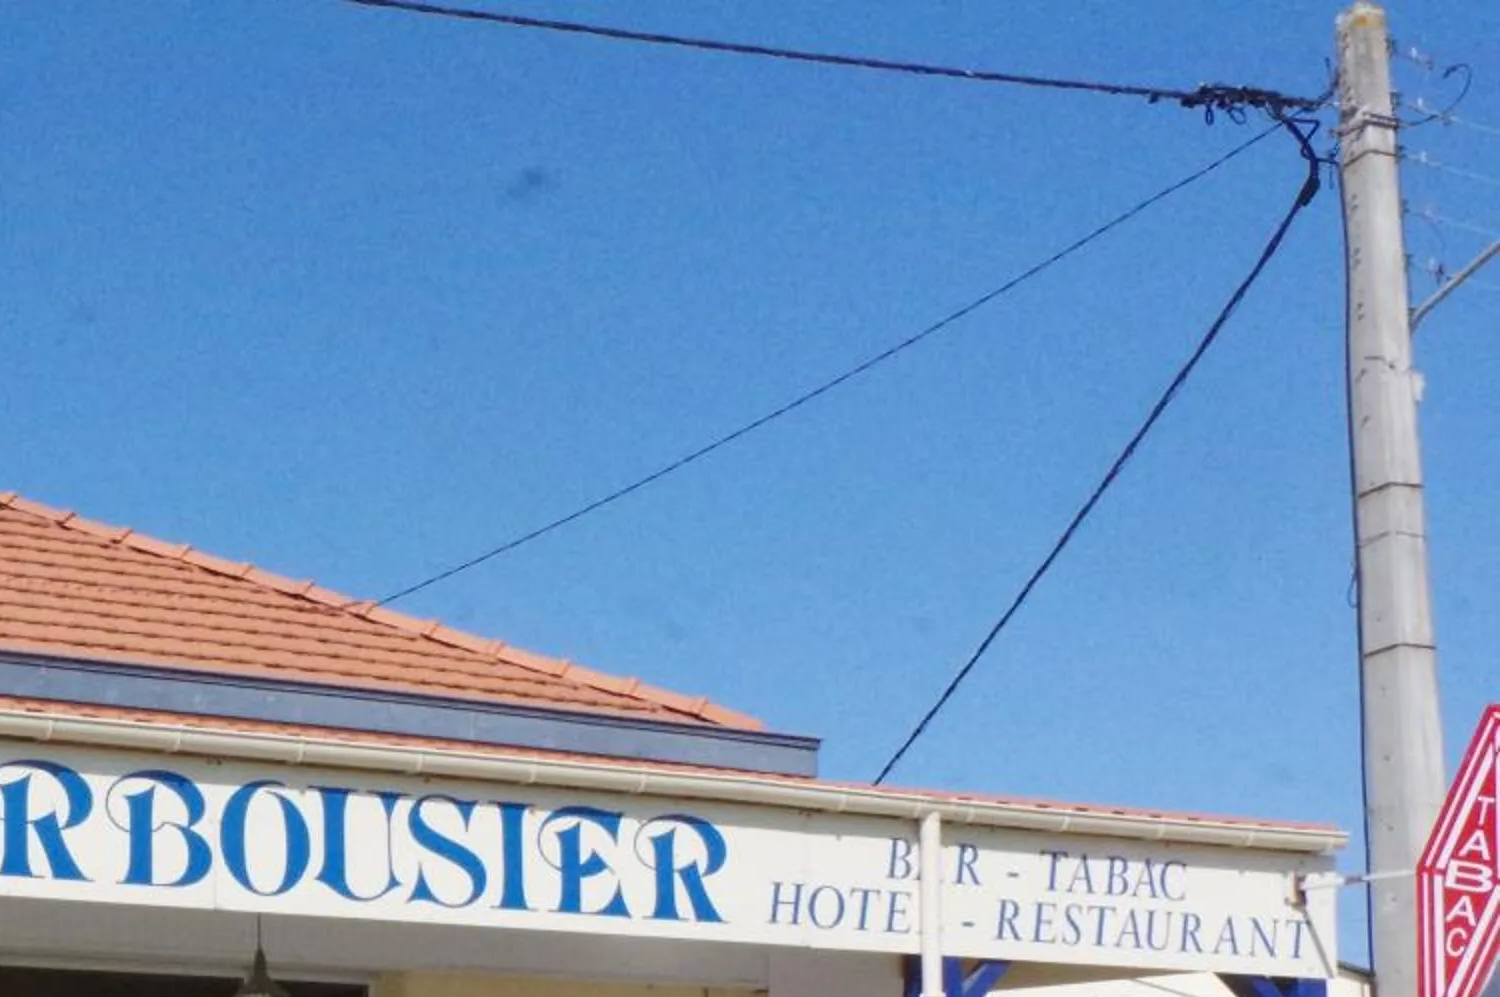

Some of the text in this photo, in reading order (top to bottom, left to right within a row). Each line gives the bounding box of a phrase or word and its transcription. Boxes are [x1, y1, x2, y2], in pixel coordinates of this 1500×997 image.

[885, 836, 982, 886] BR
[1041, 850, 1187, 902] TABAC
[1444, 796, 1494, 957] TABAC
[766, 882, 924, 934] HOTE
[994, 899, 1311, 961] RESTAURANT
